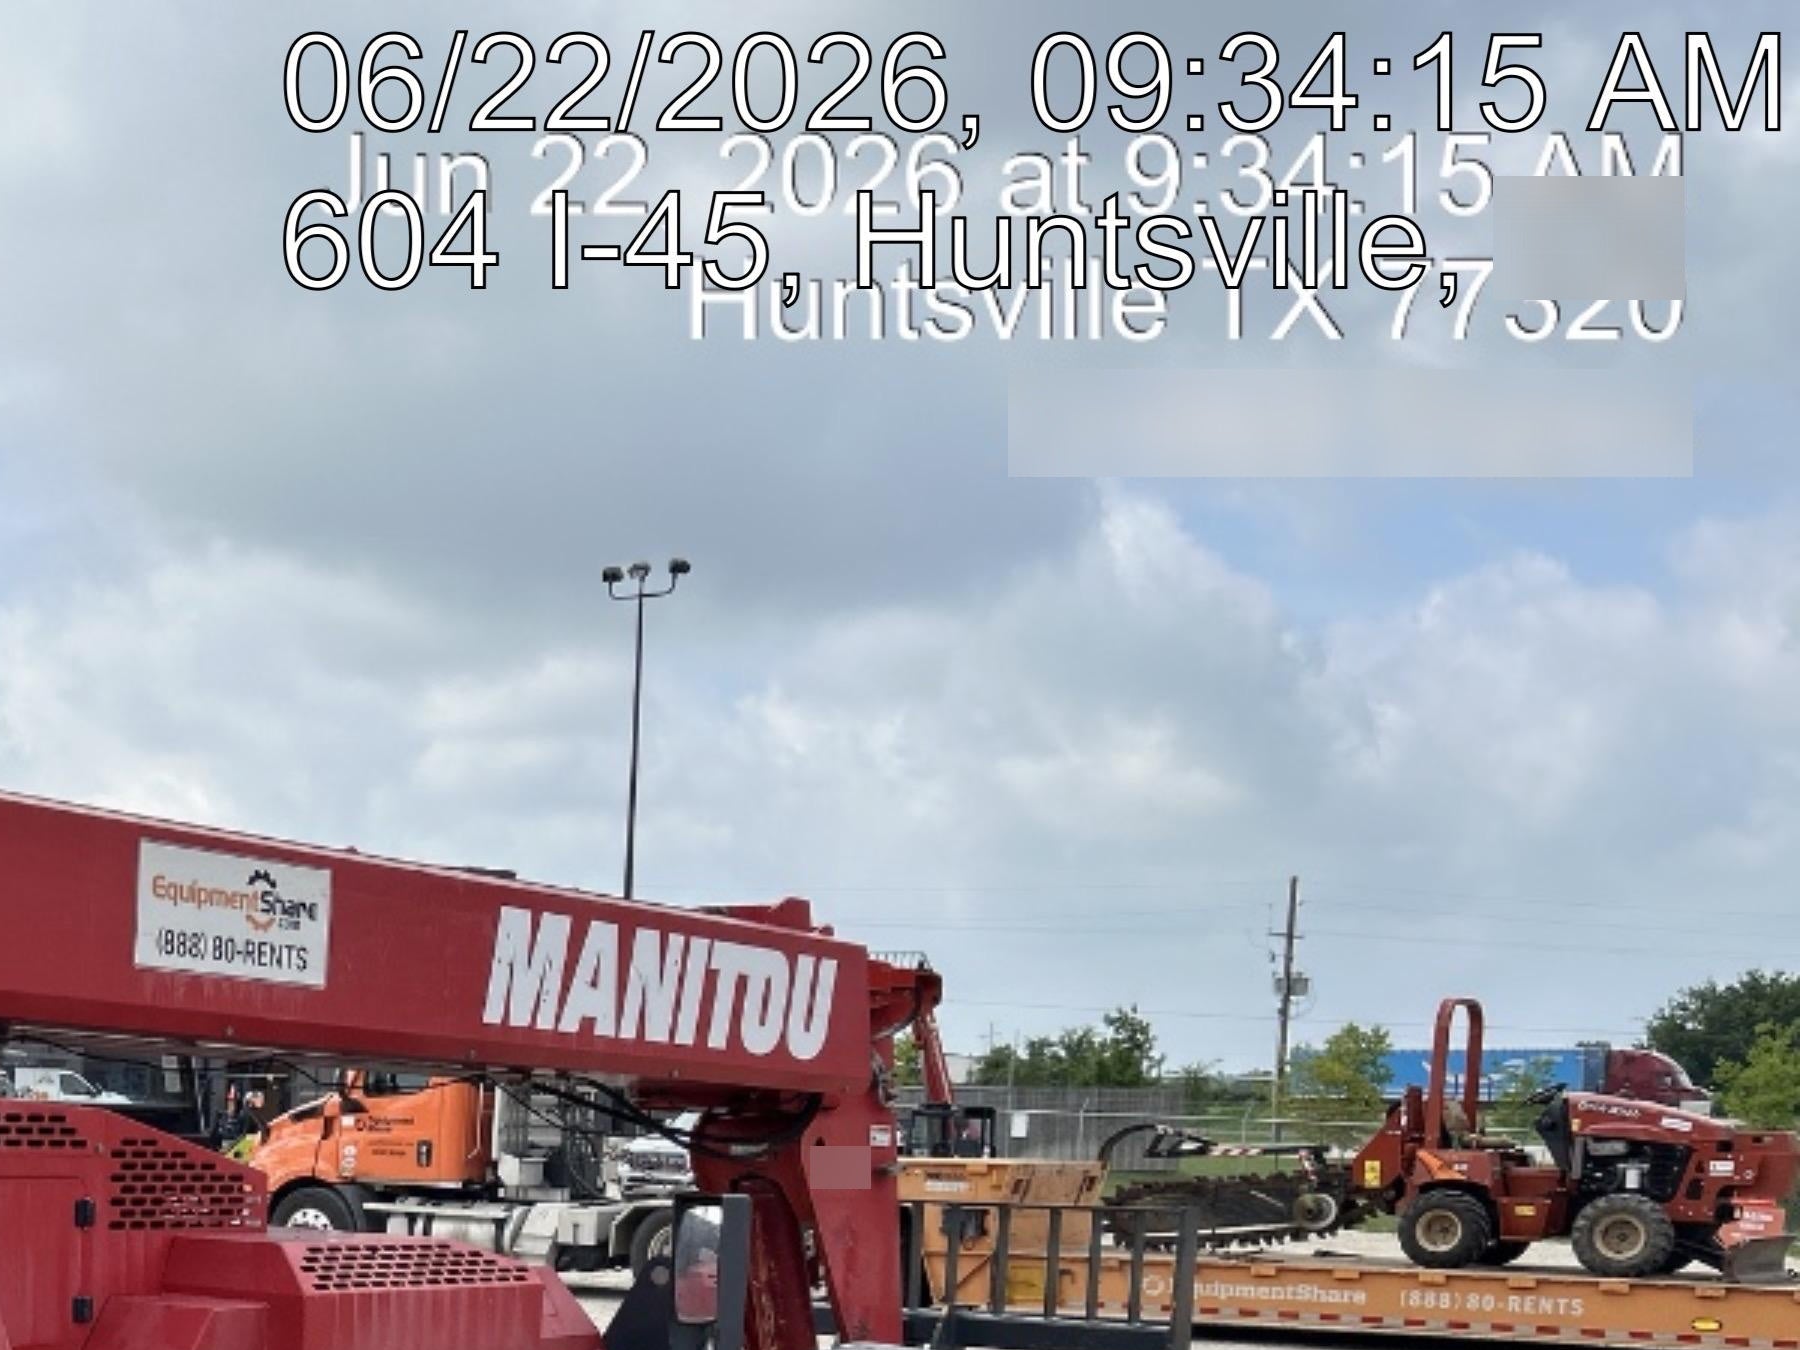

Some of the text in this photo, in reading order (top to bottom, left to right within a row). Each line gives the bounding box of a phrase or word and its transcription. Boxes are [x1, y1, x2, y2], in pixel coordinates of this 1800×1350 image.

[152, 873, 318, 921] EquipmentShare
[157, 928, 309, 972] (888) 80-RENTS
[482, 905, 838, 1061] MANITOU
